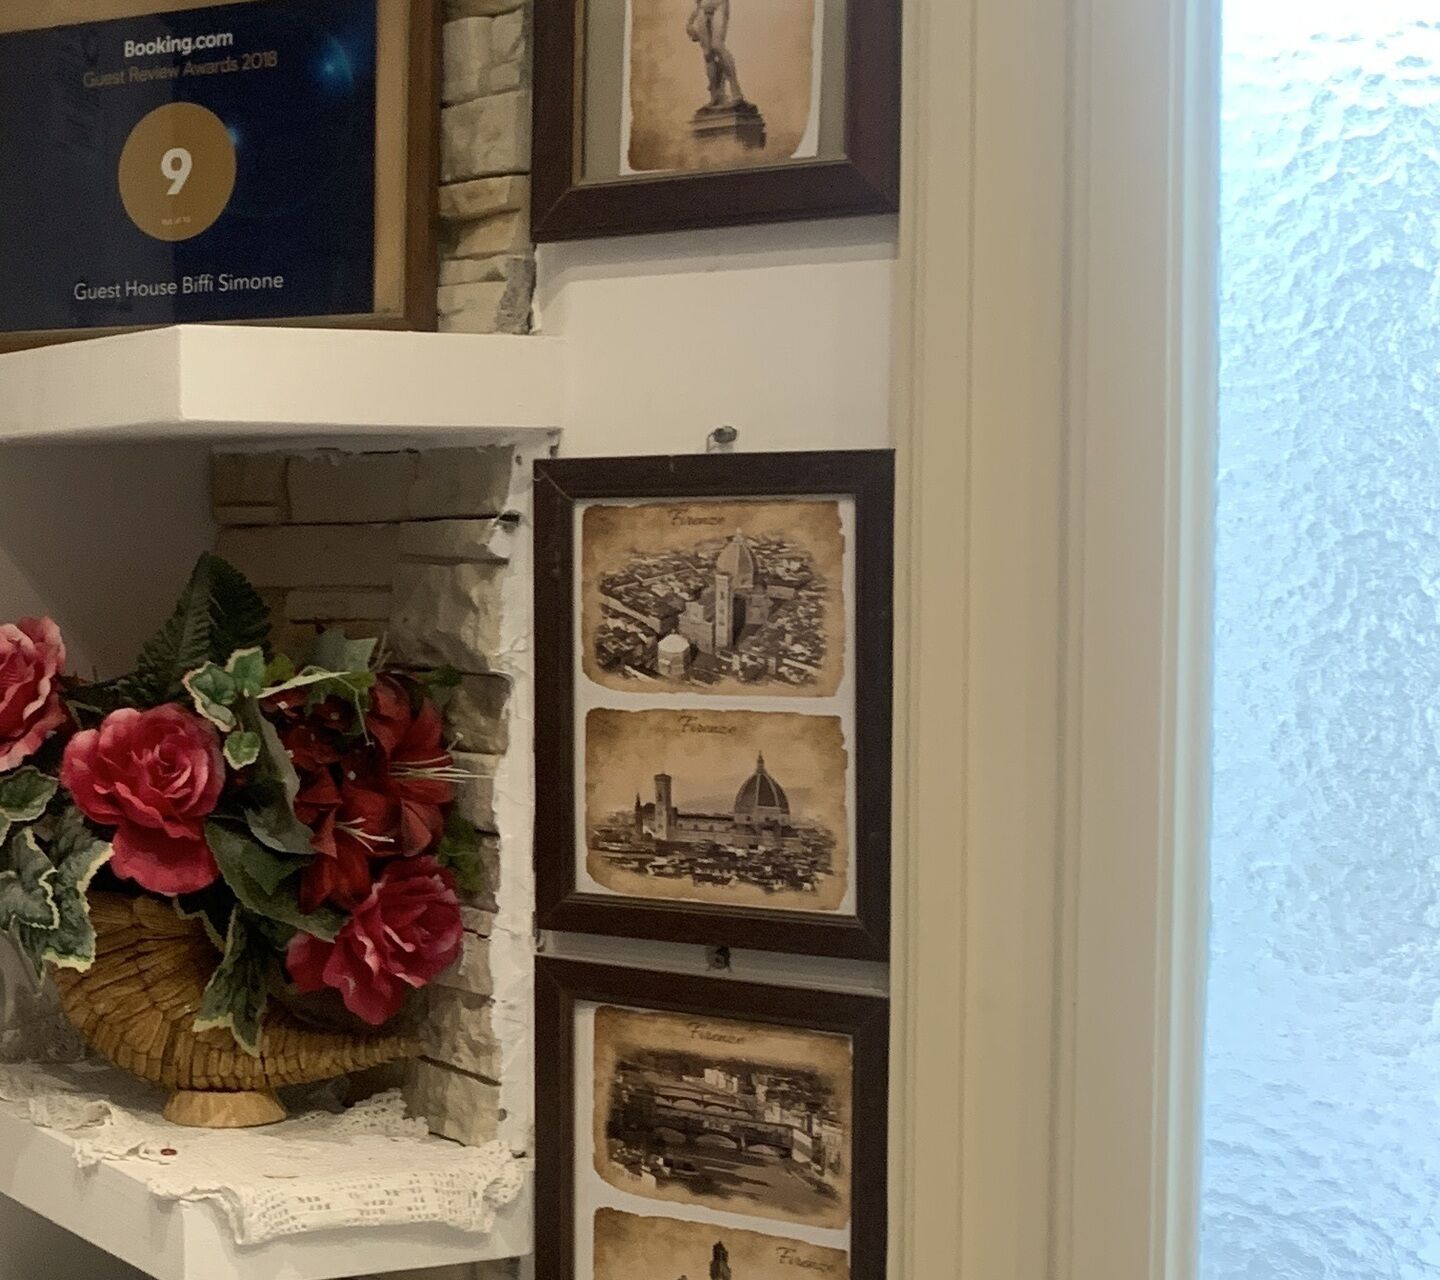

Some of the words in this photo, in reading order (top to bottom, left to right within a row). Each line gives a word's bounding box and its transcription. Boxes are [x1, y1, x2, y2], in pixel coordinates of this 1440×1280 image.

[124, 31, 233, 57] Booking.com
[83, 71, 125, 88] Guest
[129, 65, 179, 82] Review
[183, 56, 238, 76] Awards
[241, 50, 278, 70] 2018
[160, 147, 193, 196] 9
[74, 282, 121, 300] Guest
[125, 280, 178, 297] House
[182, 274, 214, 294] Biffi
[218, 273, 284, 292] Simone
